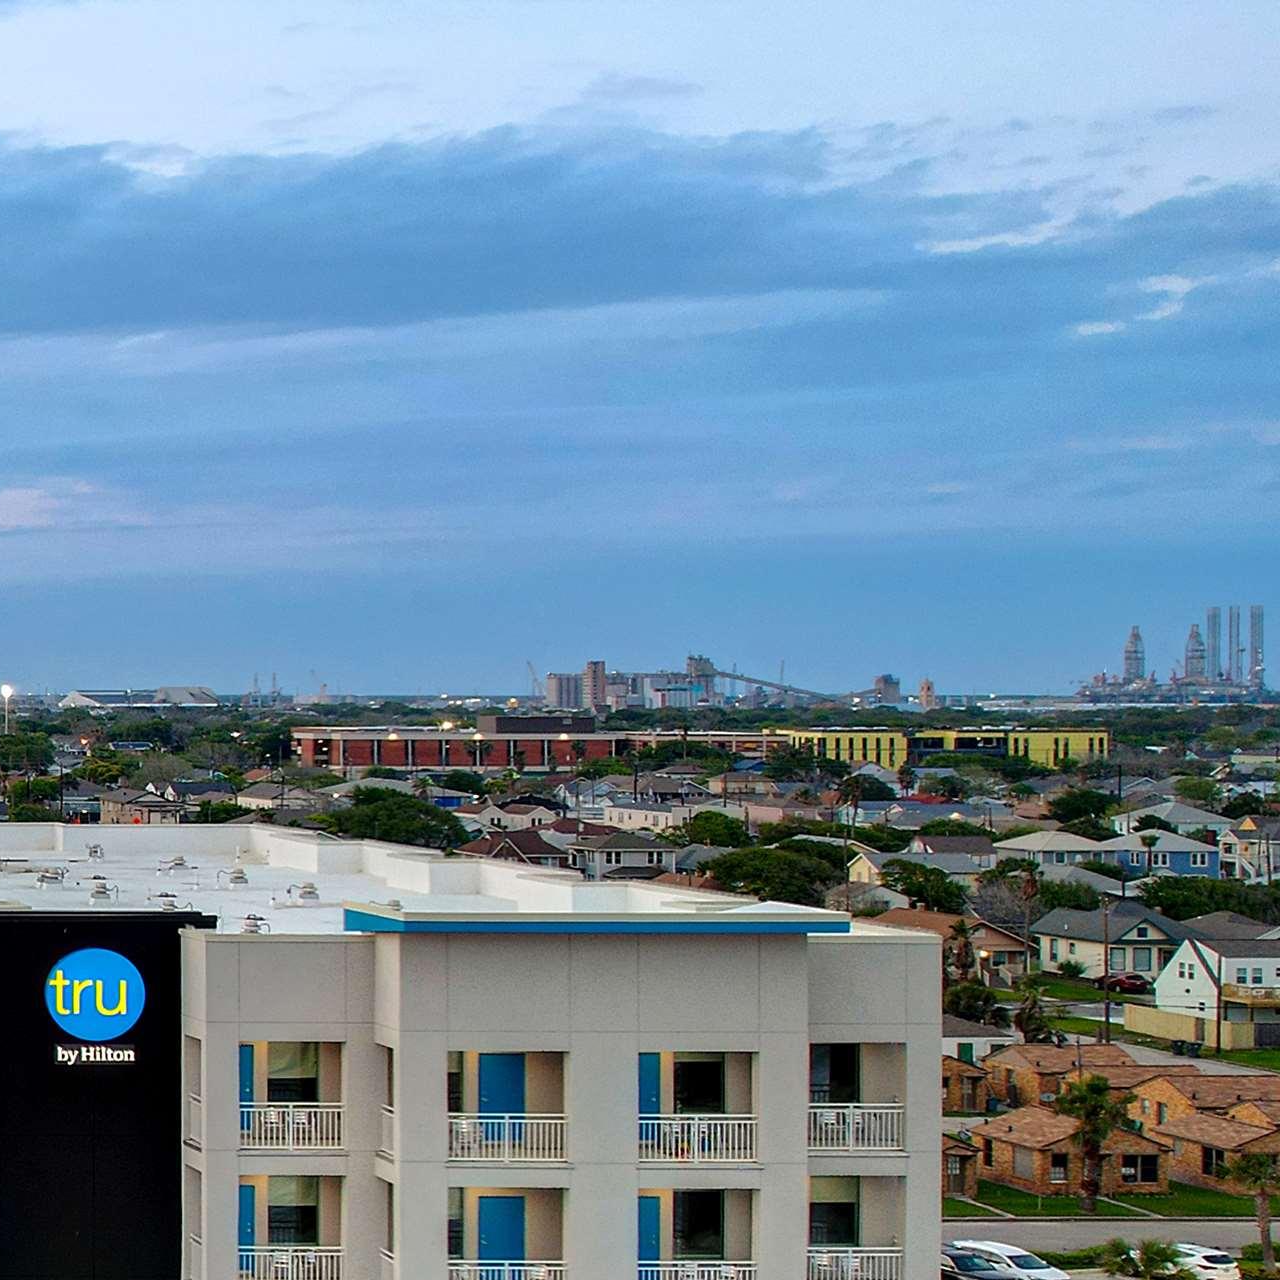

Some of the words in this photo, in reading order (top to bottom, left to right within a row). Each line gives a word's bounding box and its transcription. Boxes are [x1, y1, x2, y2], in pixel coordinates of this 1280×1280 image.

[49, 970, 127, 1016] tru
[56, 1046, 79, 1066] by
[81, 1045, 136, 1063] Hilton
